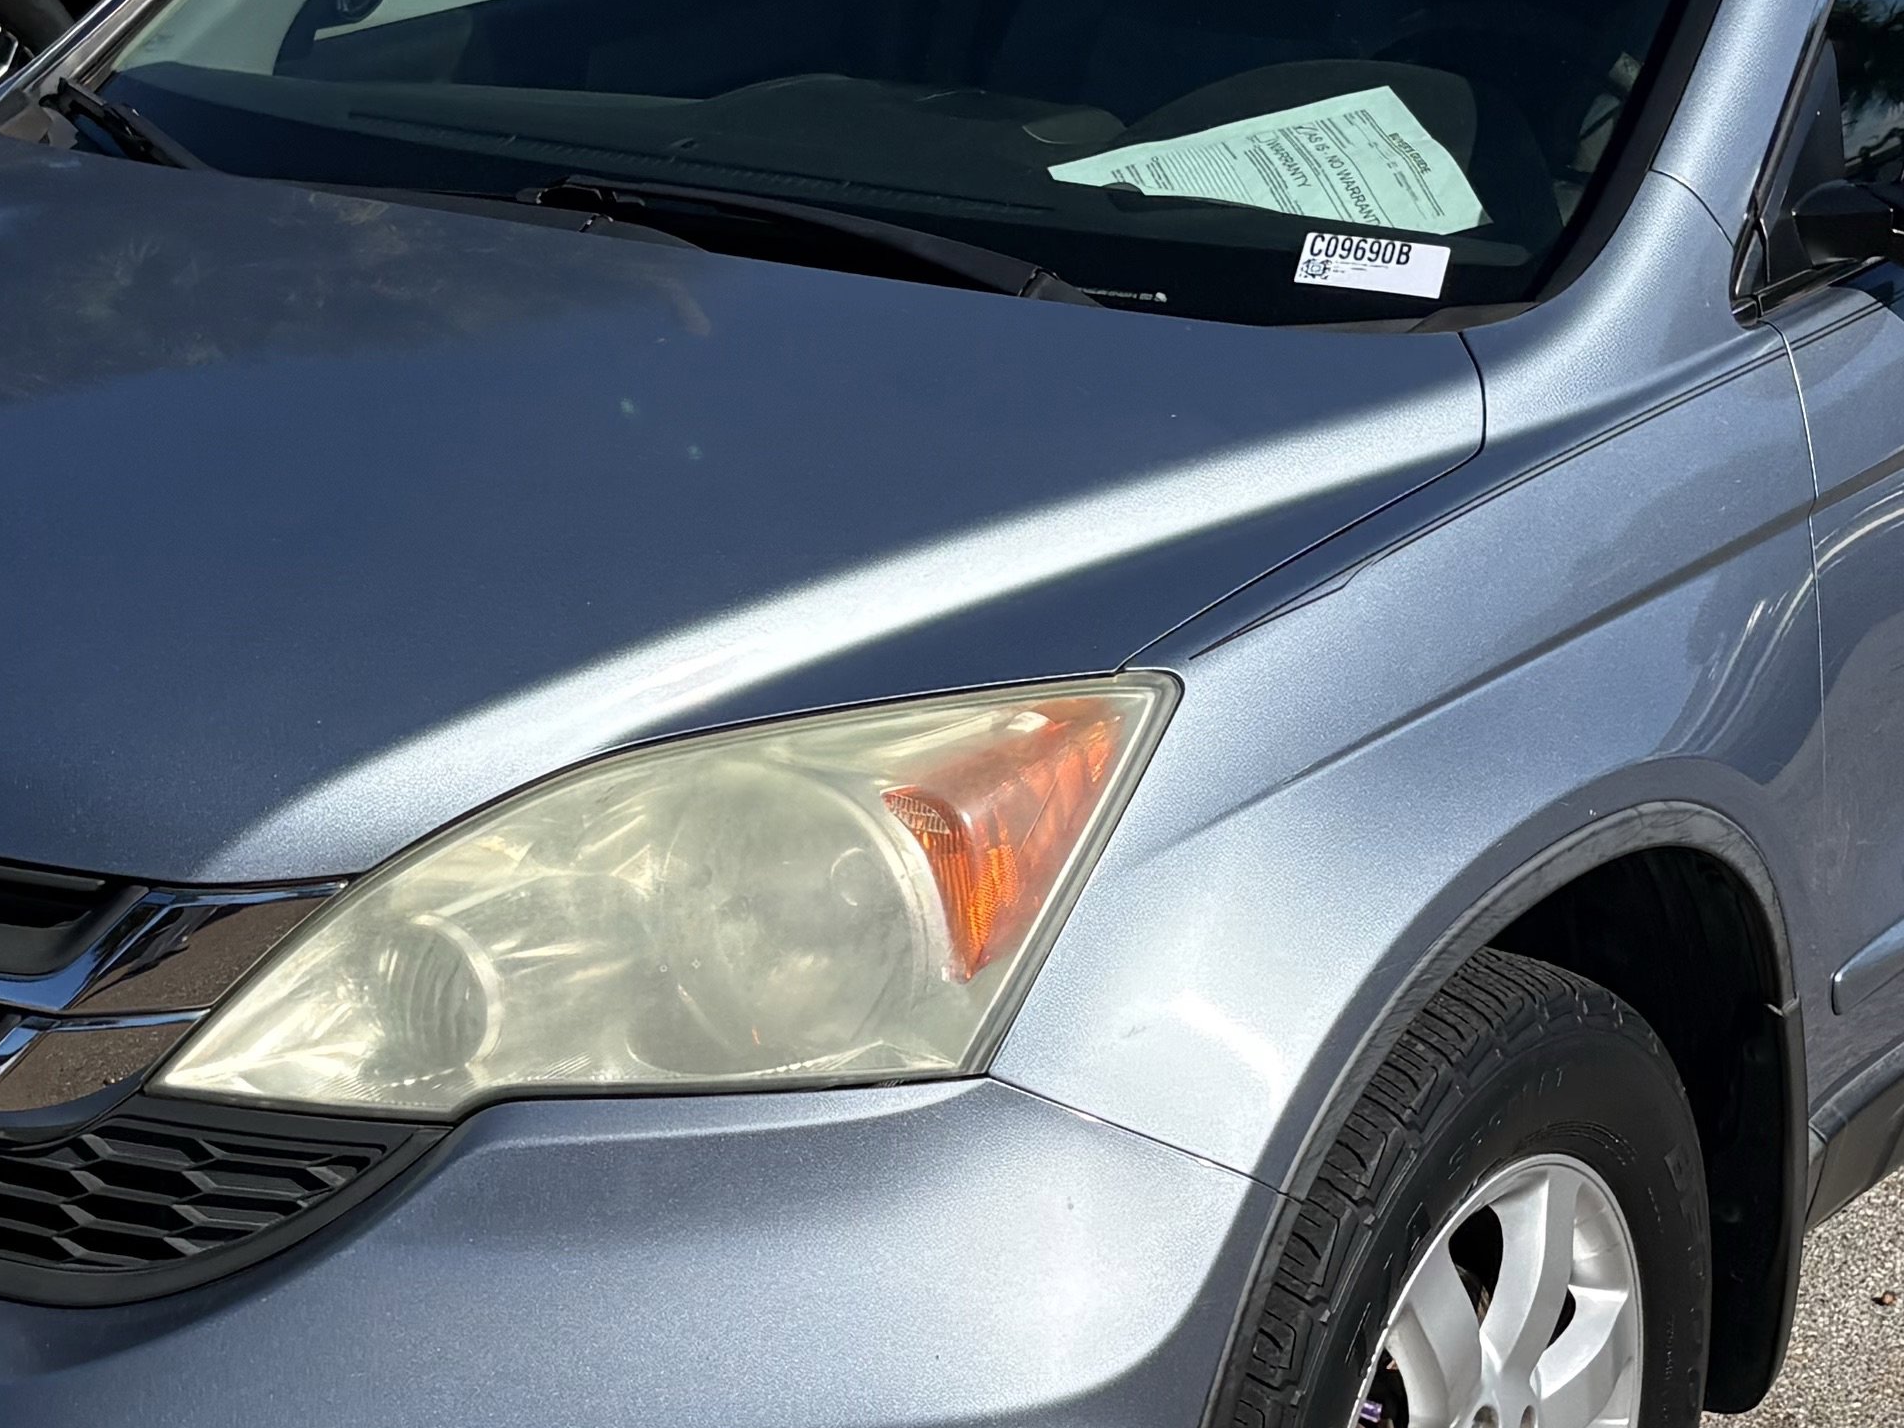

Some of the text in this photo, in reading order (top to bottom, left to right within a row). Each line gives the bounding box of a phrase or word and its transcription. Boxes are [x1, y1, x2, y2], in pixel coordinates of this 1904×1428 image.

[1267, 138, 1312, 188] WARRANTY
[1336, 169, 1381, 225] WARRANT
[1310, 234, 1412, 266] C09690B
